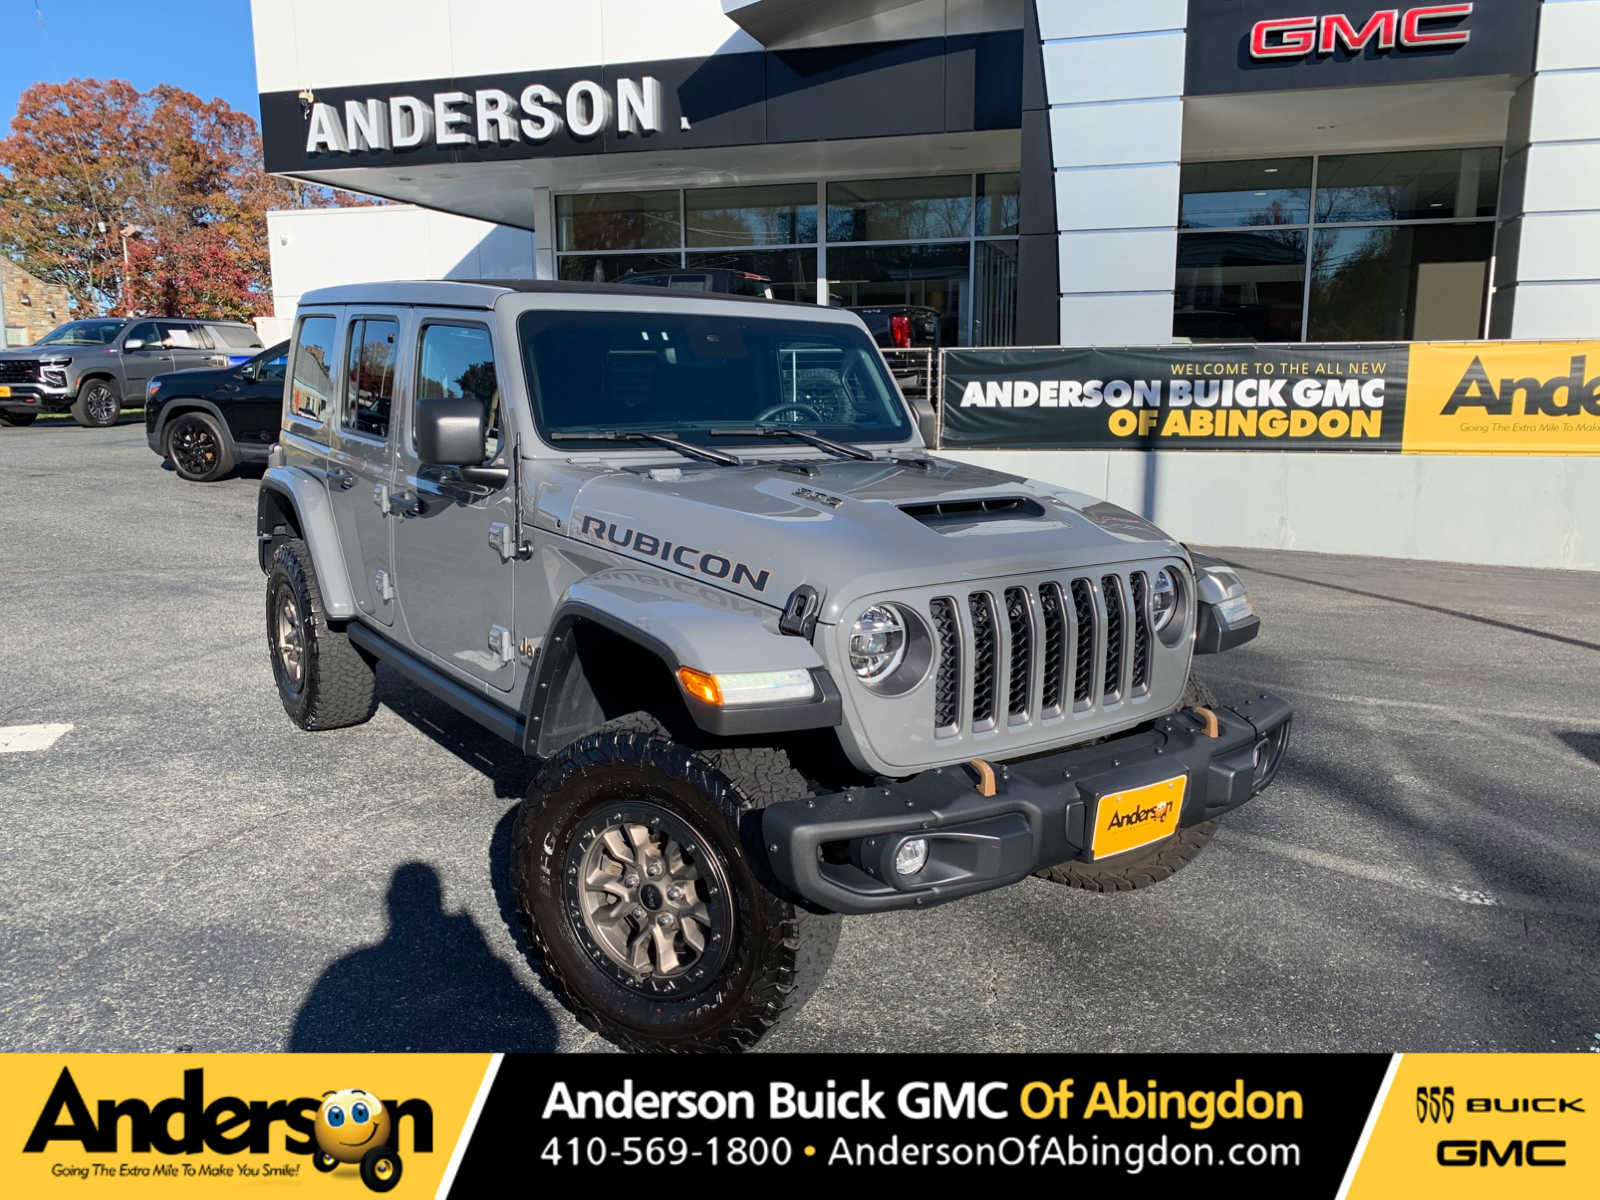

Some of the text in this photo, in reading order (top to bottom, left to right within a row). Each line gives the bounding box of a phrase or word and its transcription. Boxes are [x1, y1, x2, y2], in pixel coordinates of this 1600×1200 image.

[1250, 2, 1473, 59] GMC
[306, 76, 661, 153] ANDERSON
[1170, 362, 1386, 376] WELCOME TO THE ALL NEW
[960, 378, 1385, 408] ANDERSON BUICK GMC
[1108, 408, 1382, 438] OF ABINGDON
[1459, 422, 1489, 434] Going
[1492, 422, 1511, 432] The
[1512, 422, 1537, 432] Extra
[1538, 423, 1560, 433] Mile
[1562, 422, 1574, 433] To
[581, 515, 770, 592] RUBICON
